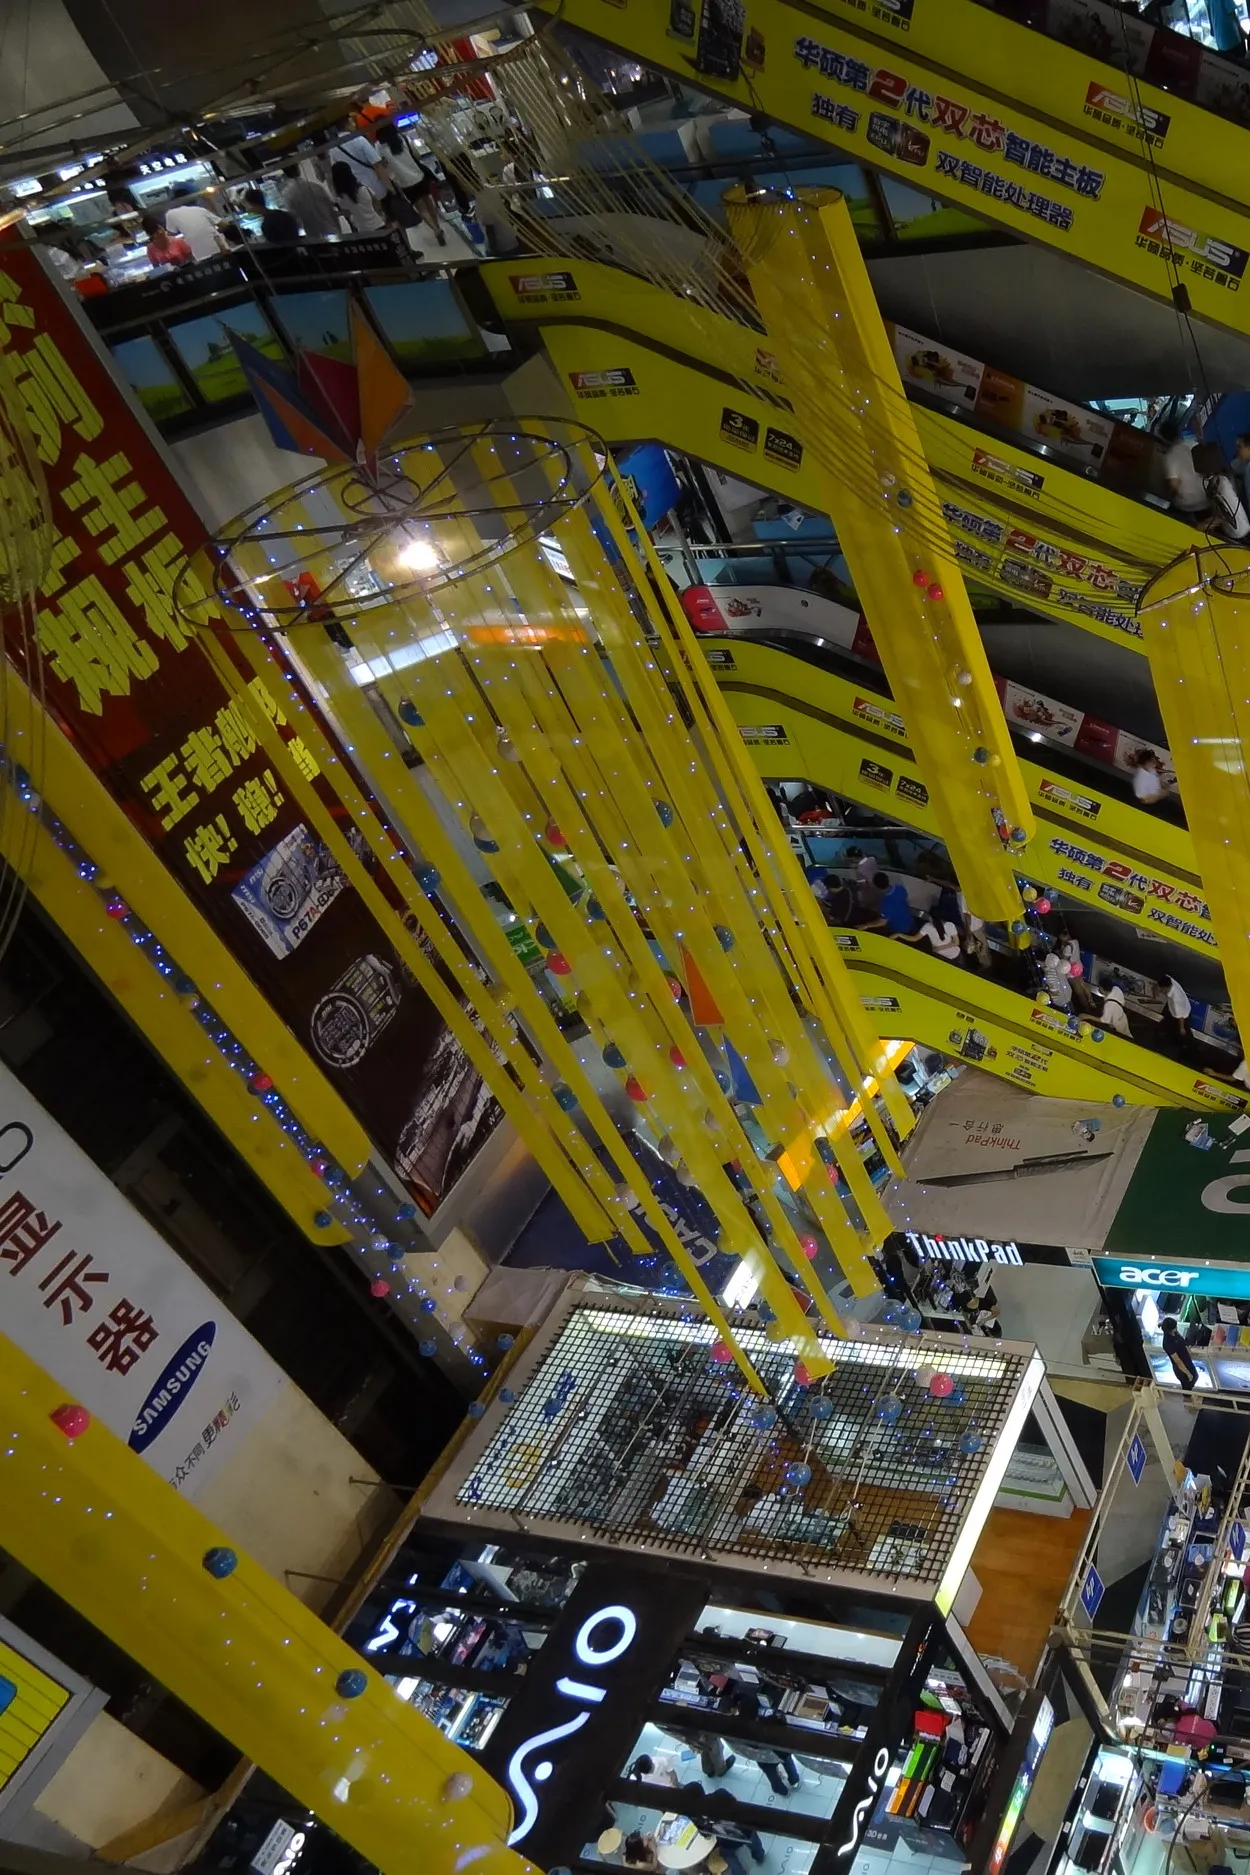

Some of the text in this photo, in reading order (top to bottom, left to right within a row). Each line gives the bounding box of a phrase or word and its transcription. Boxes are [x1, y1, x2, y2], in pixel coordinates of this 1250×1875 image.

[794, 35, 1106, 202] 华硕第2代双芯智能主板
[810, 92, 860, 132] 独有
[1090, 86, 1164, 130] ASUS
[933, 149, 1075, 232] 双智能处理器
[1146, 217, 1233, 269] ASUS
[1042, 783, 1094, 810] ASUS
[1057, 866, 1095, 893] 独有
[965, 1133, 1021, 1150] ThinkPad
[907, 1231, 1024, 1267] ThinkPad
[1119, 1265, 1200, 1289] acer
[131, 1339, 213, 1437] SAMSUNG
[837, 1747, 890, 1858] VAIO
